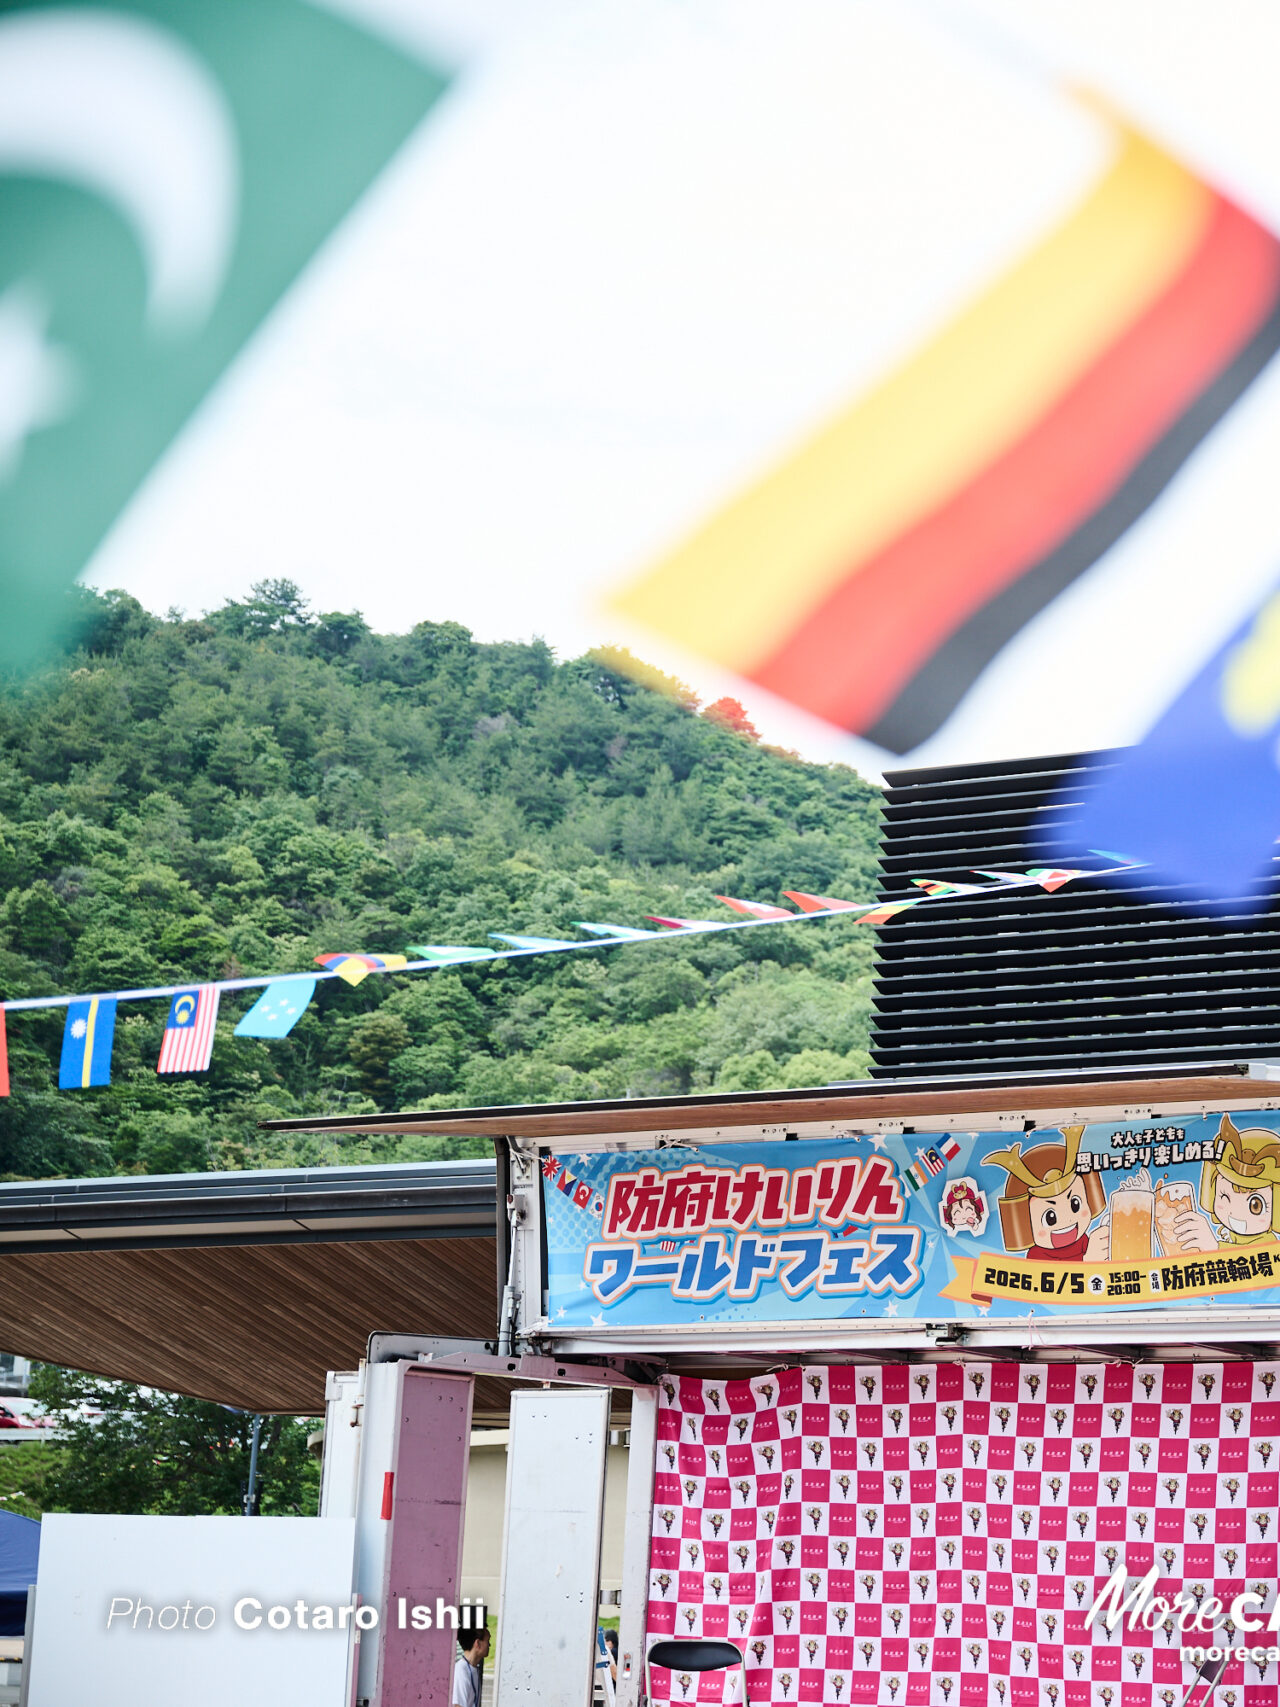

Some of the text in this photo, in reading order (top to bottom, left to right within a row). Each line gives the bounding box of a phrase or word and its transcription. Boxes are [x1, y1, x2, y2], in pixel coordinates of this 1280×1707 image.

[1111, 1127, 1185, 1148] 大人も子どもも
[606, 1157, 902, 1236] 防府けいりん
[588, 1229, 918, 1297] ワールドフェス
[1161, 1252, 1274, 1291] 防府競輪場
[984, 1267, 1103, 1294] 2026.6/5 金
[1106, 1283, 1141, 1296] 20:00
